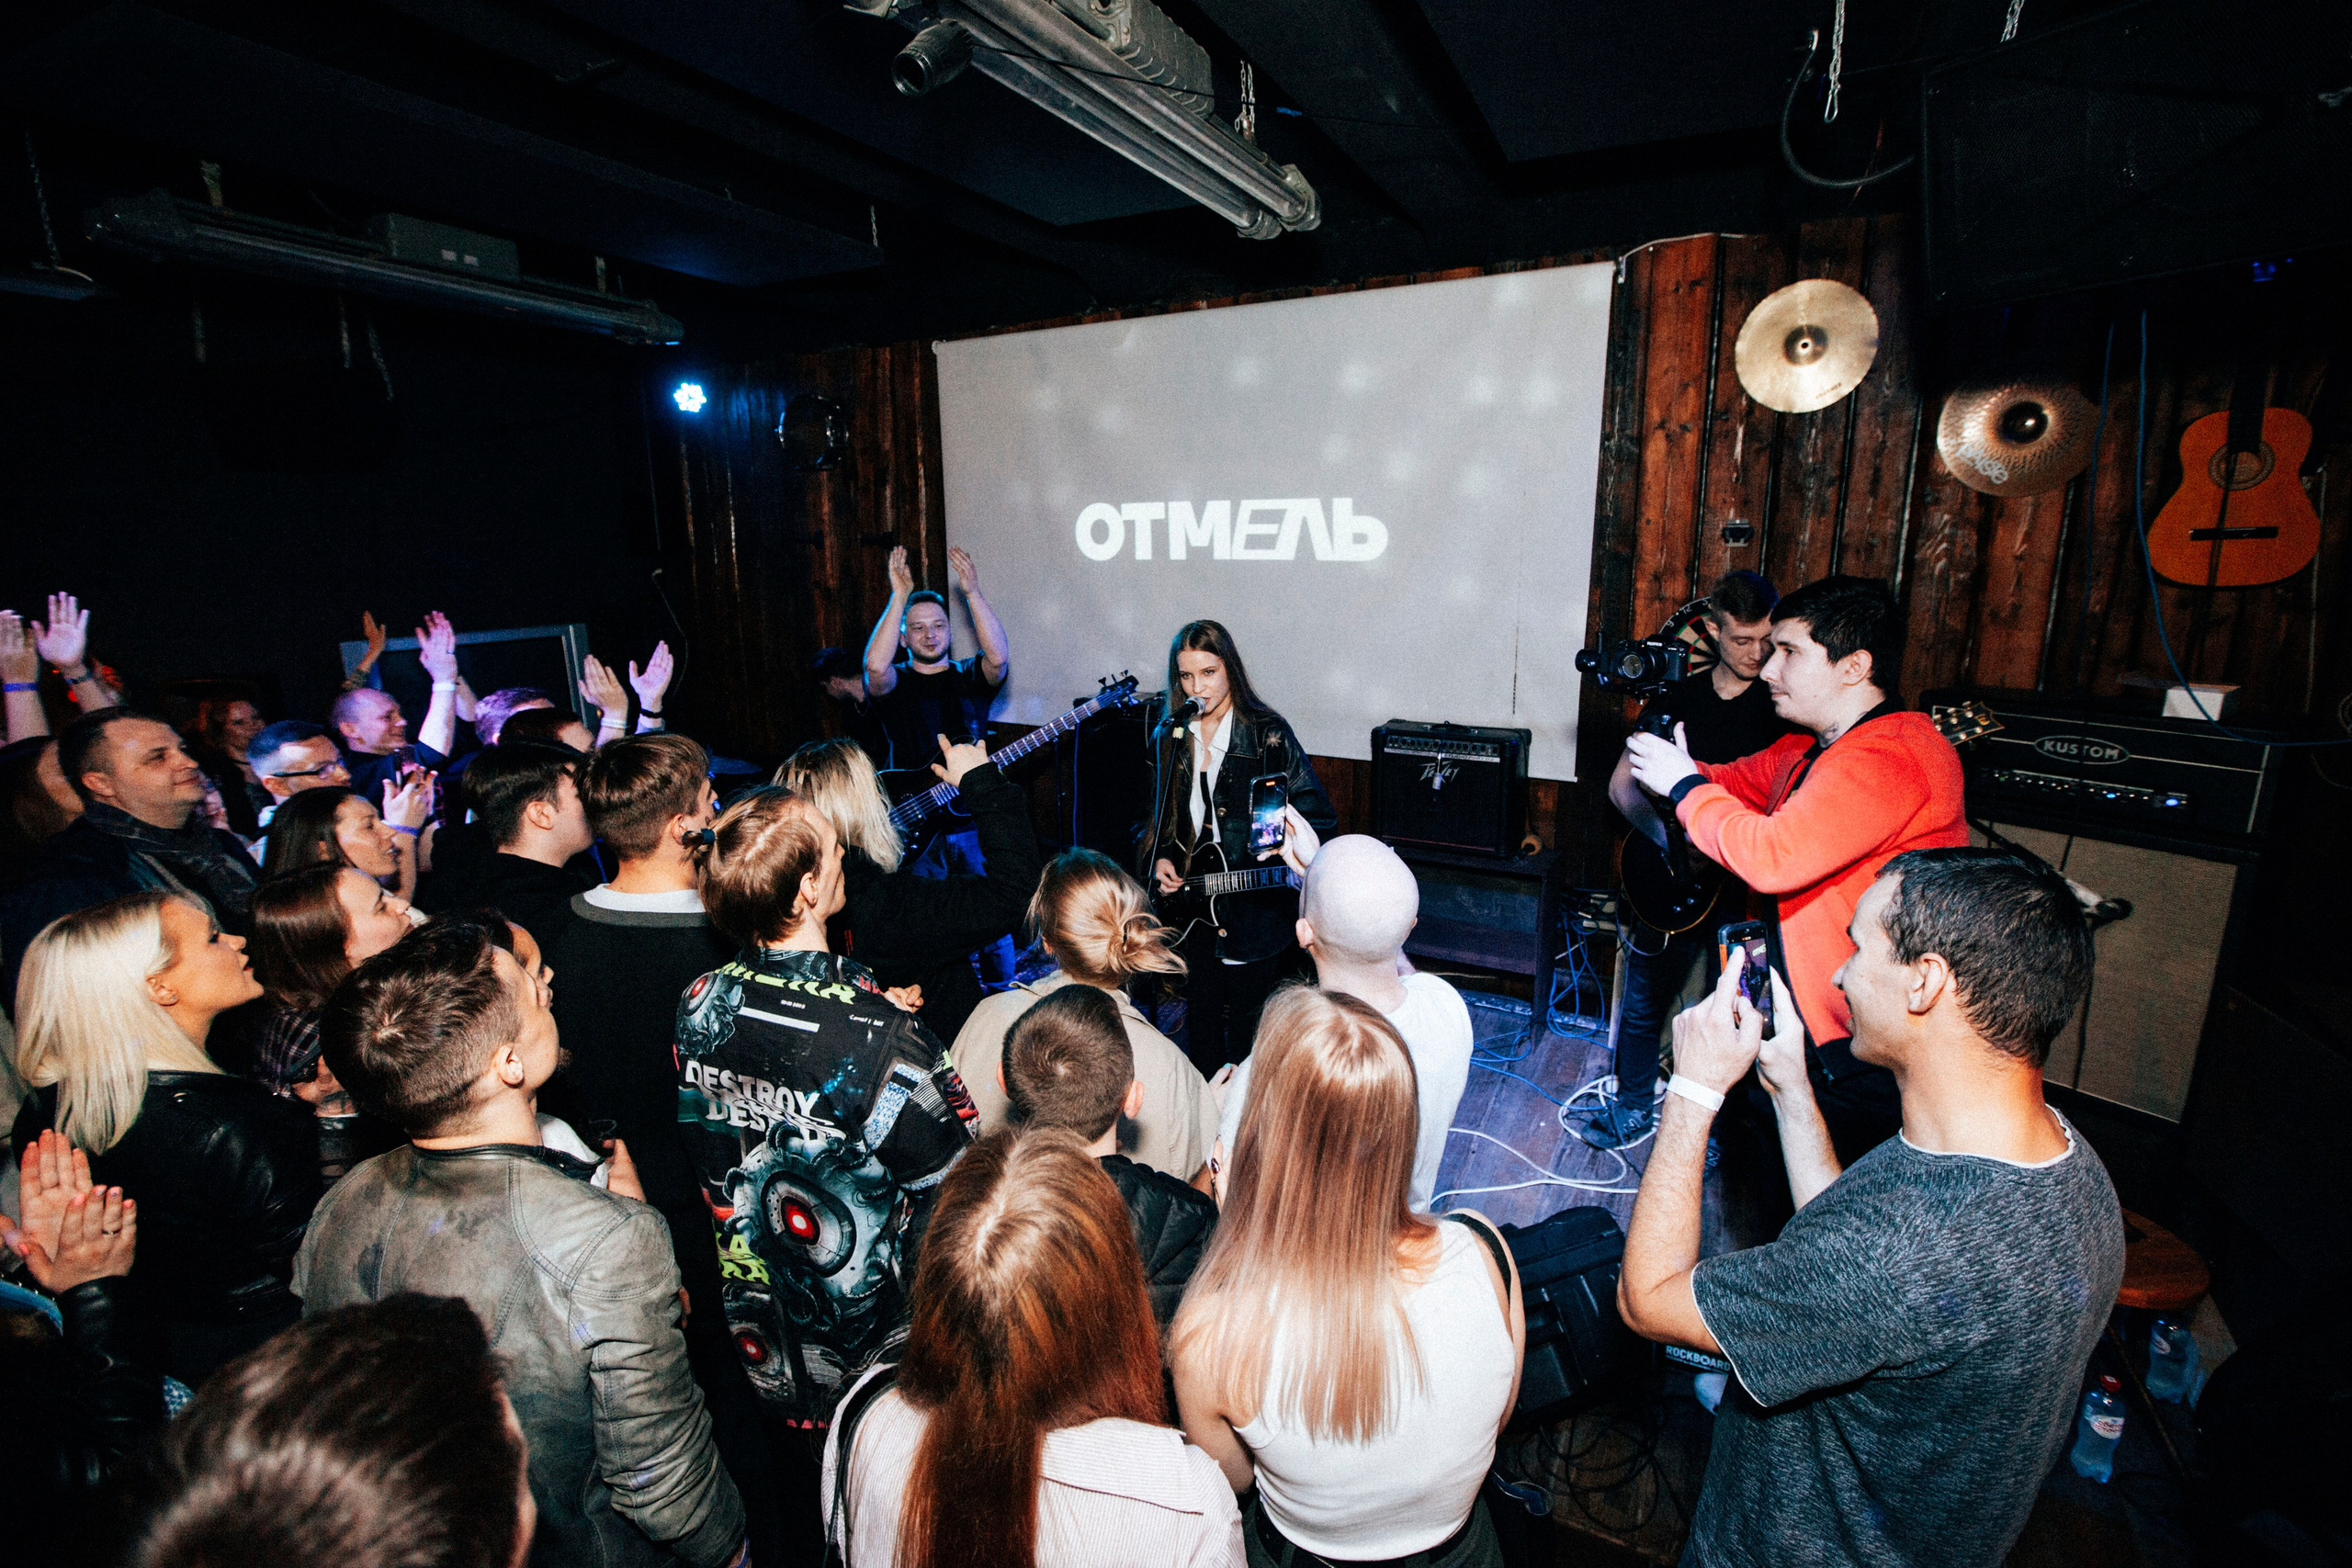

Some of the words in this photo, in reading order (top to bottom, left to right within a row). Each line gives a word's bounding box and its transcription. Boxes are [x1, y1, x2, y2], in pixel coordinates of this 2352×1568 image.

[1075, 497, 1389, 561] ОТМЕЛЬ
[2043, 740, 2120, 760] KUSTOM
[1418, 760, 1461, 784] PEVEY
[685, 1060, 821, 1118] DESTROY
[1666, 1345, 1731, 1371] ROCKBOARD
